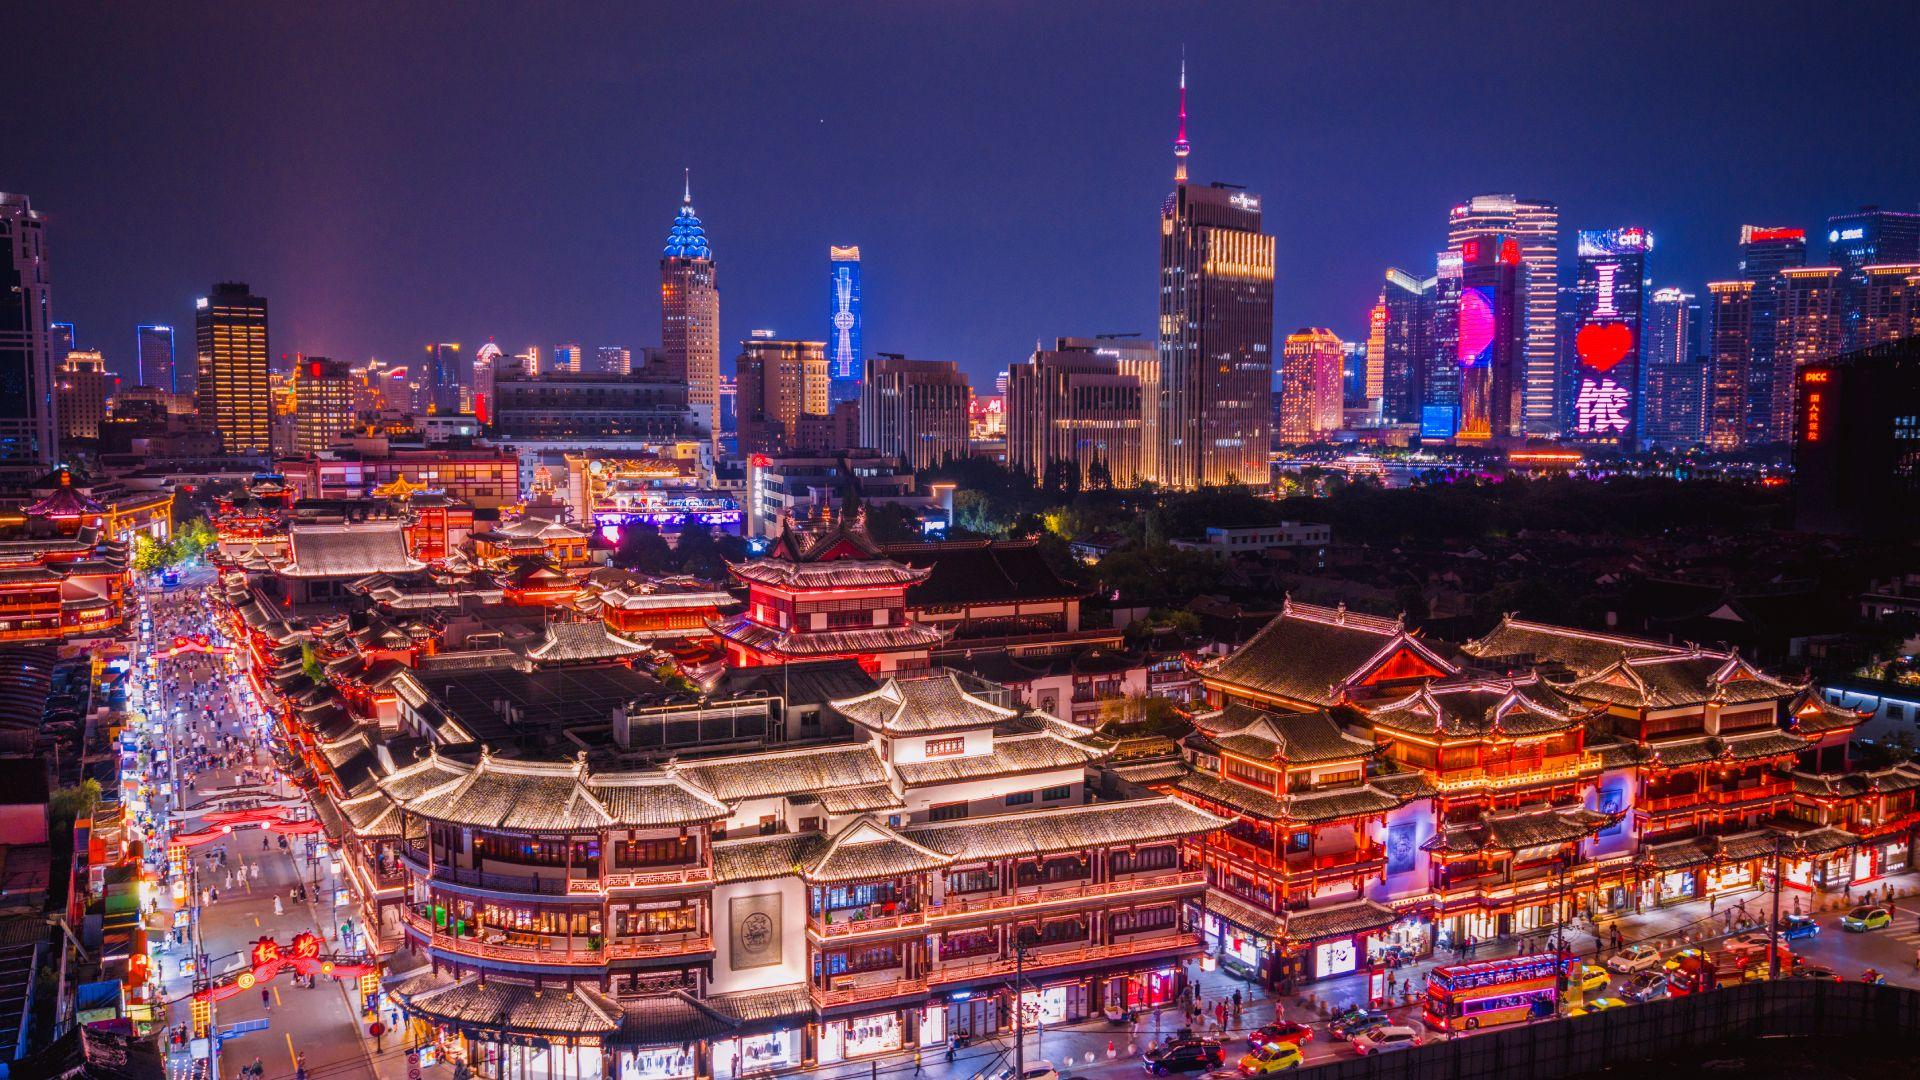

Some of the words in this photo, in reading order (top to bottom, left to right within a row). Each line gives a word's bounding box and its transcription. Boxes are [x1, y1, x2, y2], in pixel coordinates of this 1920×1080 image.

[1618, 233, 1641, 246] citi
[1595, 265, 1619, 316] I
[1805, 373, 1827, 381] PICC
[1575, 379, 1630, 433] 侬
